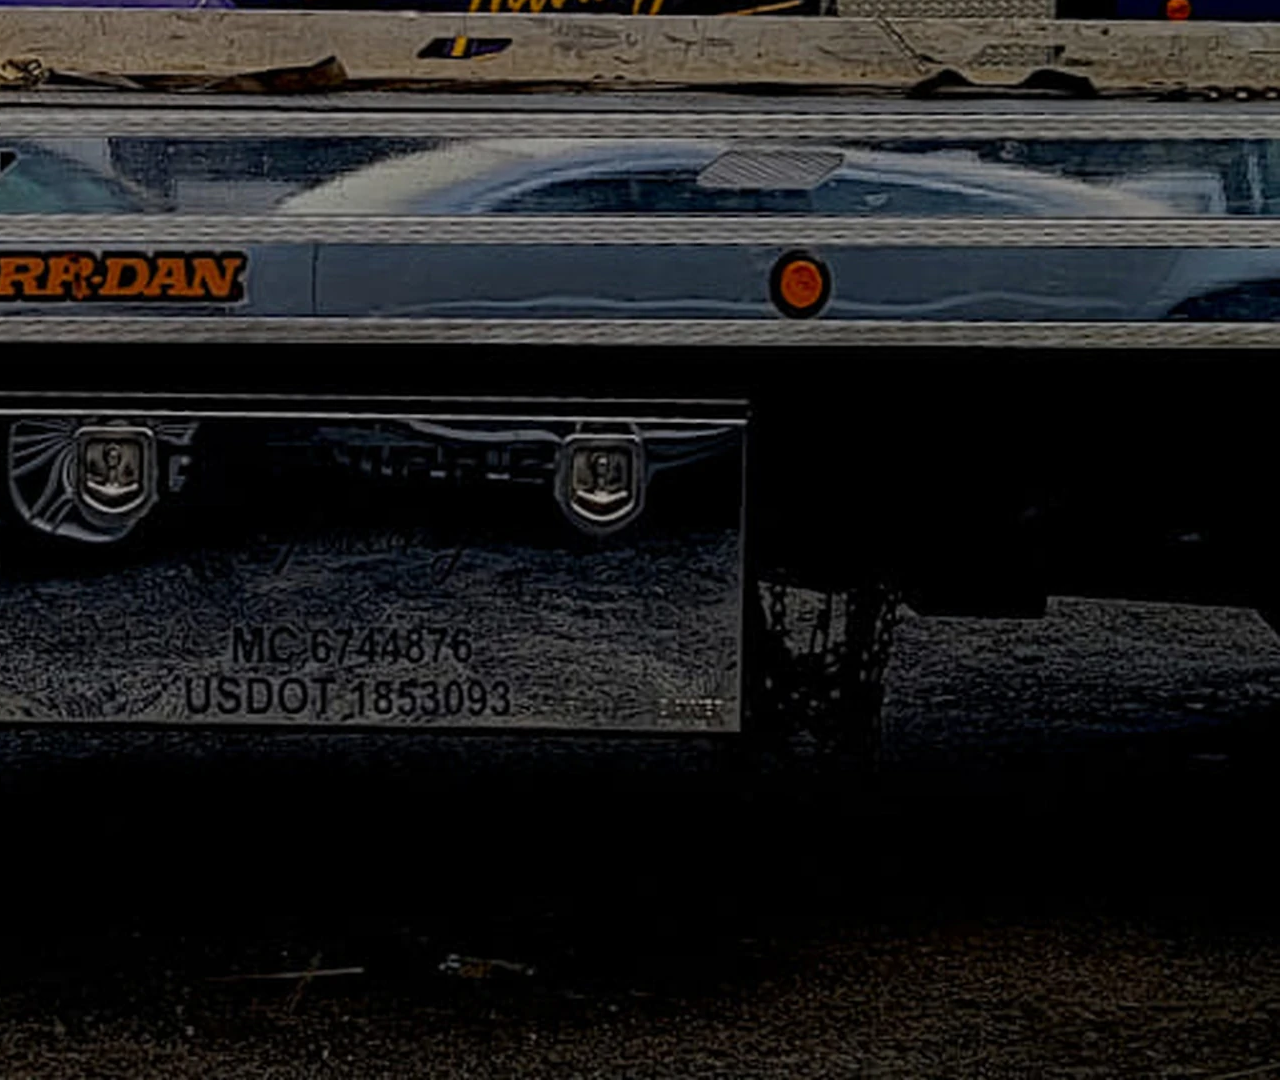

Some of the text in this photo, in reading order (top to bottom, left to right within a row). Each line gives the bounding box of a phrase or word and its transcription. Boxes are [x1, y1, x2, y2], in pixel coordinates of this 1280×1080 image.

[232, 627, 473, 666] MC 6744876
[184, 677, 512, 717] USDOT 1853093
